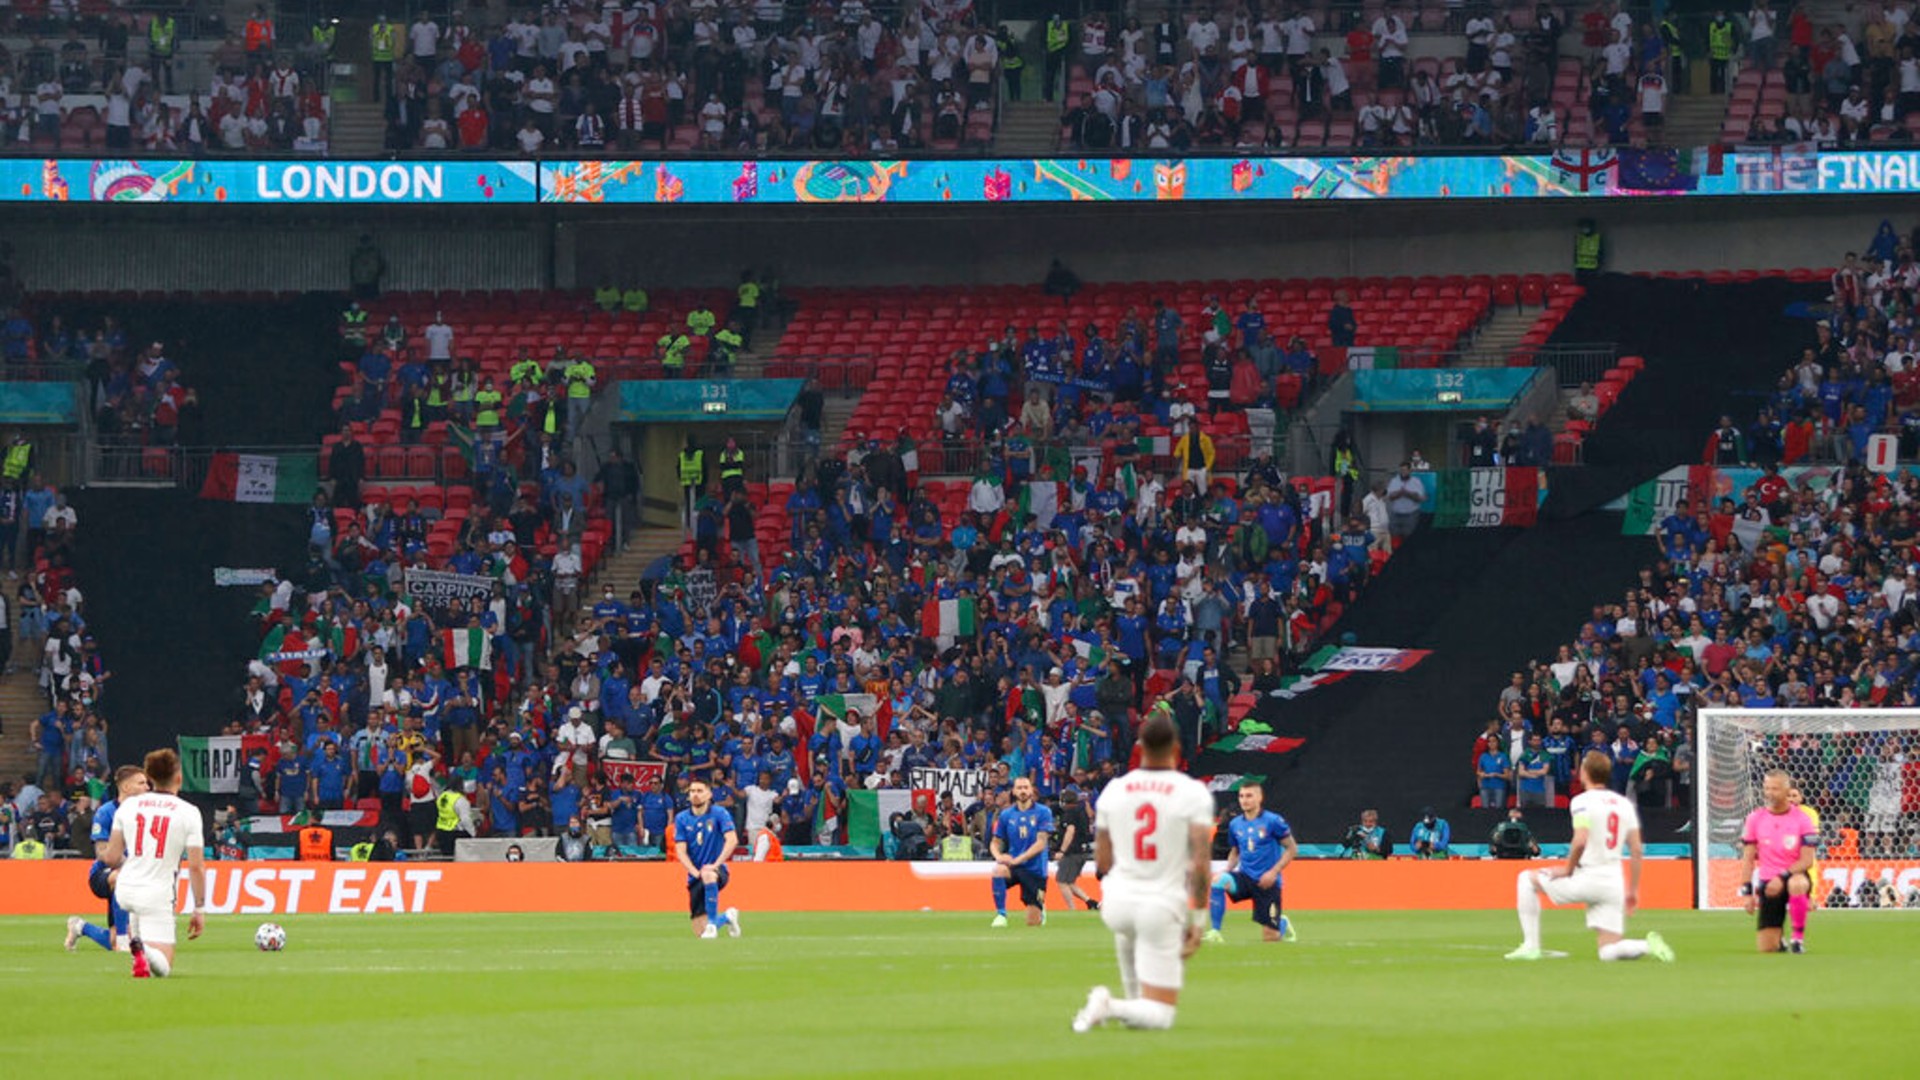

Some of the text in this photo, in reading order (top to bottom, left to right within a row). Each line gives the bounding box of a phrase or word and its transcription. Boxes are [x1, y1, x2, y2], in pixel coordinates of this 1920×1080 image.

[257, 164, 443, 199] LONDON
[1817, 154, 1920, 190] FINAL
[701, 383, 728, 398] 131
[1435, 372, 1464, 388] 132
[134, 812, 171, 859] 14
[1134, 801, 1158, 861] 2
[1605, 811, 1620, 850] 9
[177, 867, 443, 914] JUST EAT
